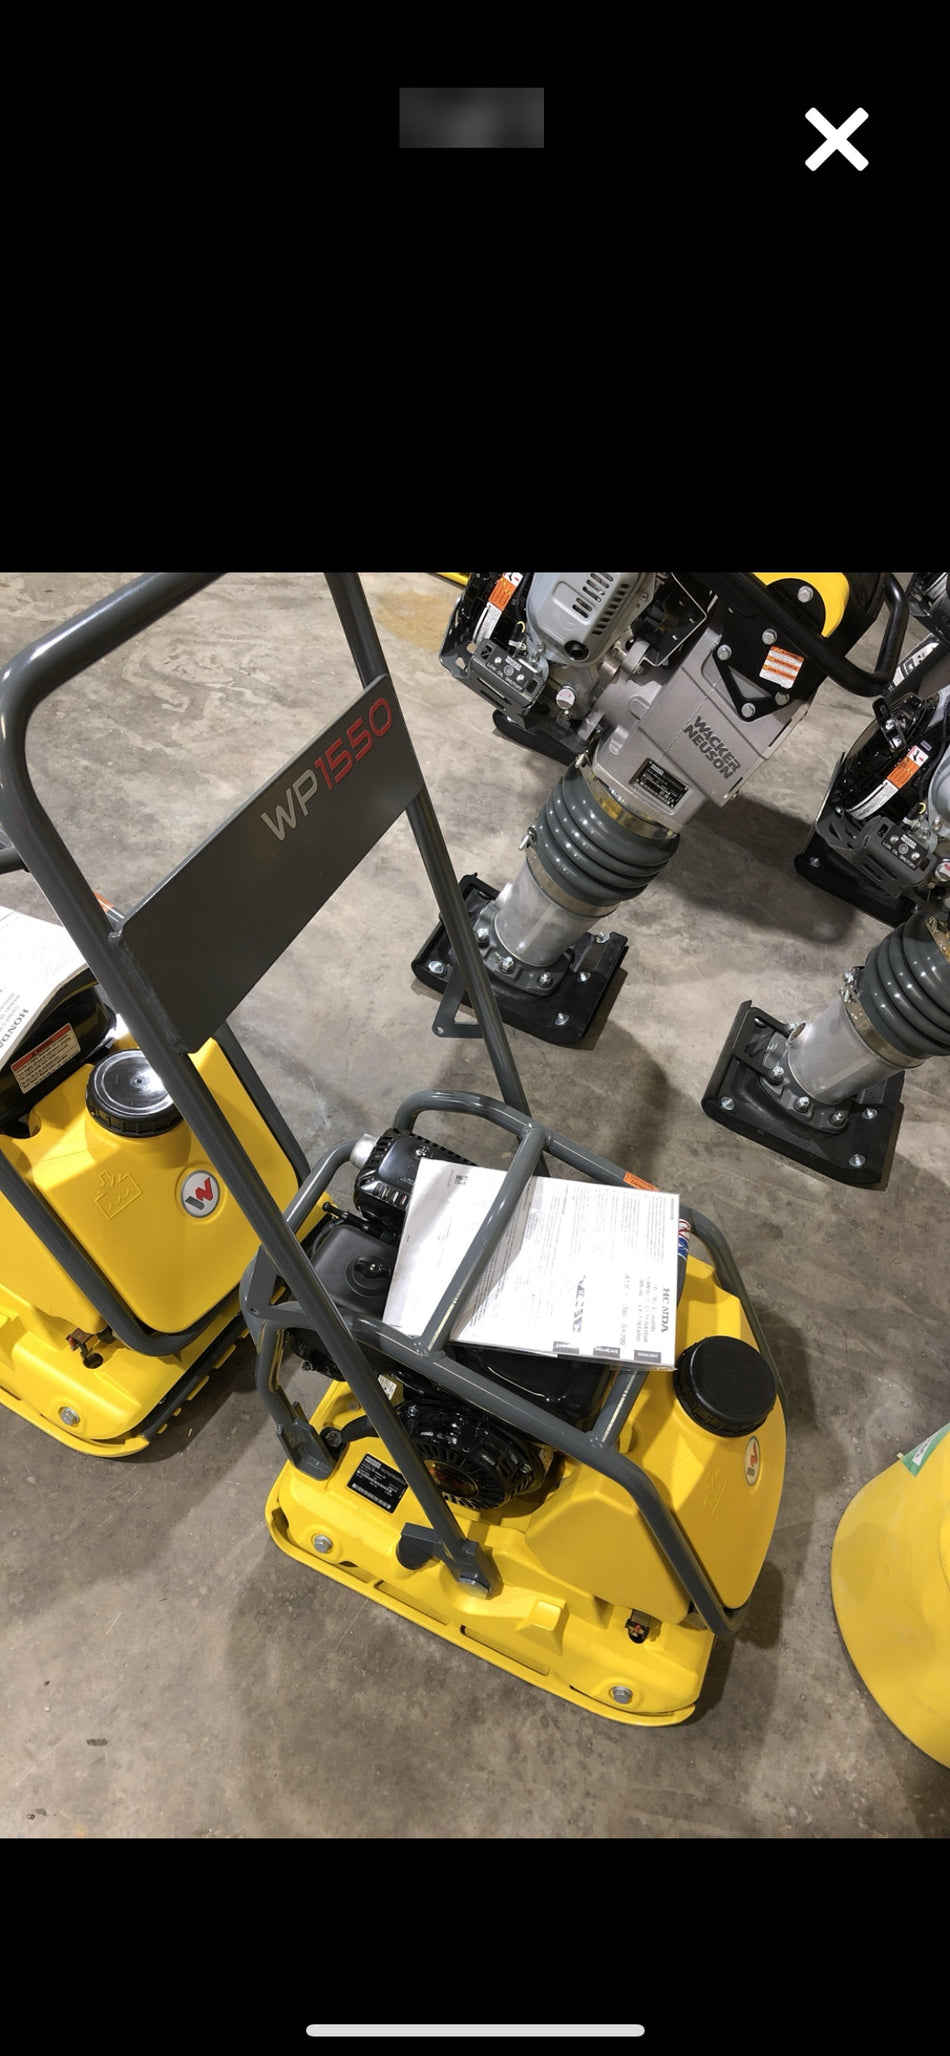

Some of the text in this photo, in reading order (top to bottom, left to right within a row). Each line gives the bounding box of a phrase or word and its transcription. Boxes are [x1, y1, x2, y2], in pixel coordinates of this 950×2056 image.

[260, 697, 393, 841] WP1550
[683, 724, 734, 779] NEUSON
[694, 715, 741, 772] WACKER
